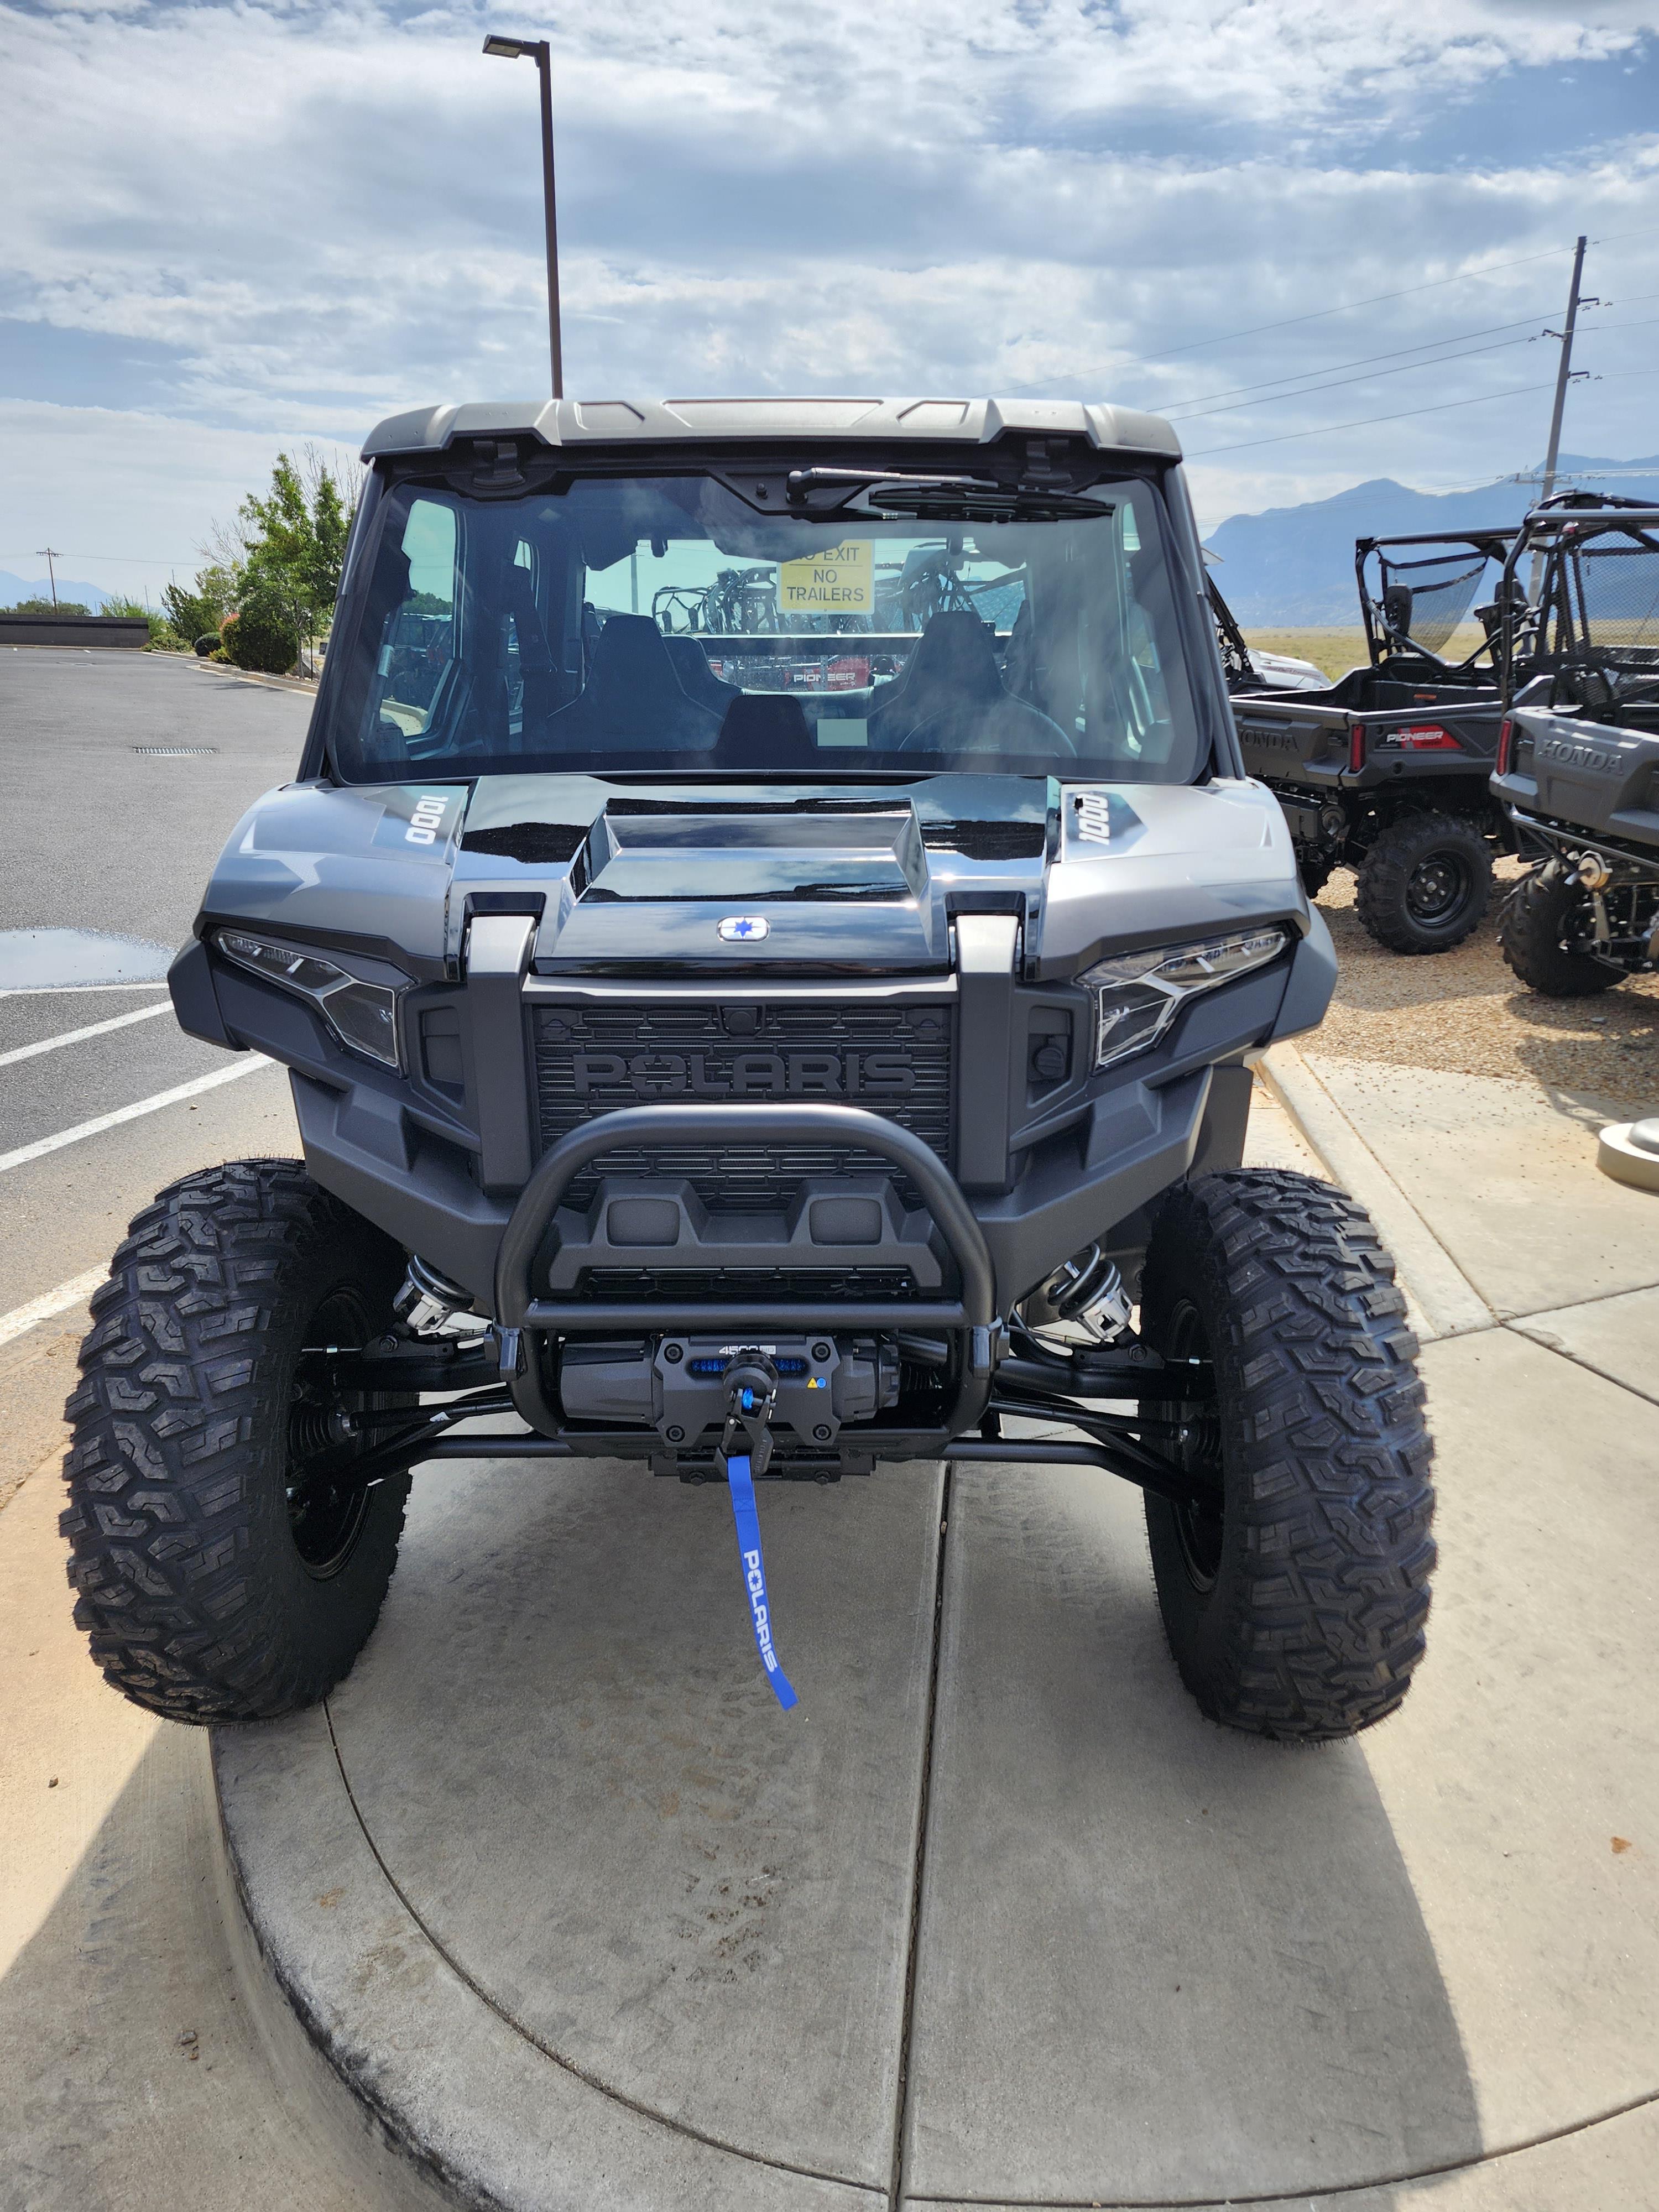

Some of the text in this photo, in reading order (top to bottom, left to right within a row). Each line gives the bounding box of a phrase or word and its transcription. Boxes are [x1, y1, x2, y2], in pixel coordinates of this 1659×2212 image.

[823, 547, 860, 561] EXIT
[813, 569, 837, 583] NO
[786, 587, 864, 602] TRAILERS
[1386, 731, 1444, 743] PIONEER
[1538, 739, 1624, 775] HONDA
[405, 795, 449, 845] 1000
[1078, 793, 1110, 846] 1000
[573, 1054, 916, 1092] POLARIS
[744, 1550, 778, 1673] POLARIS
